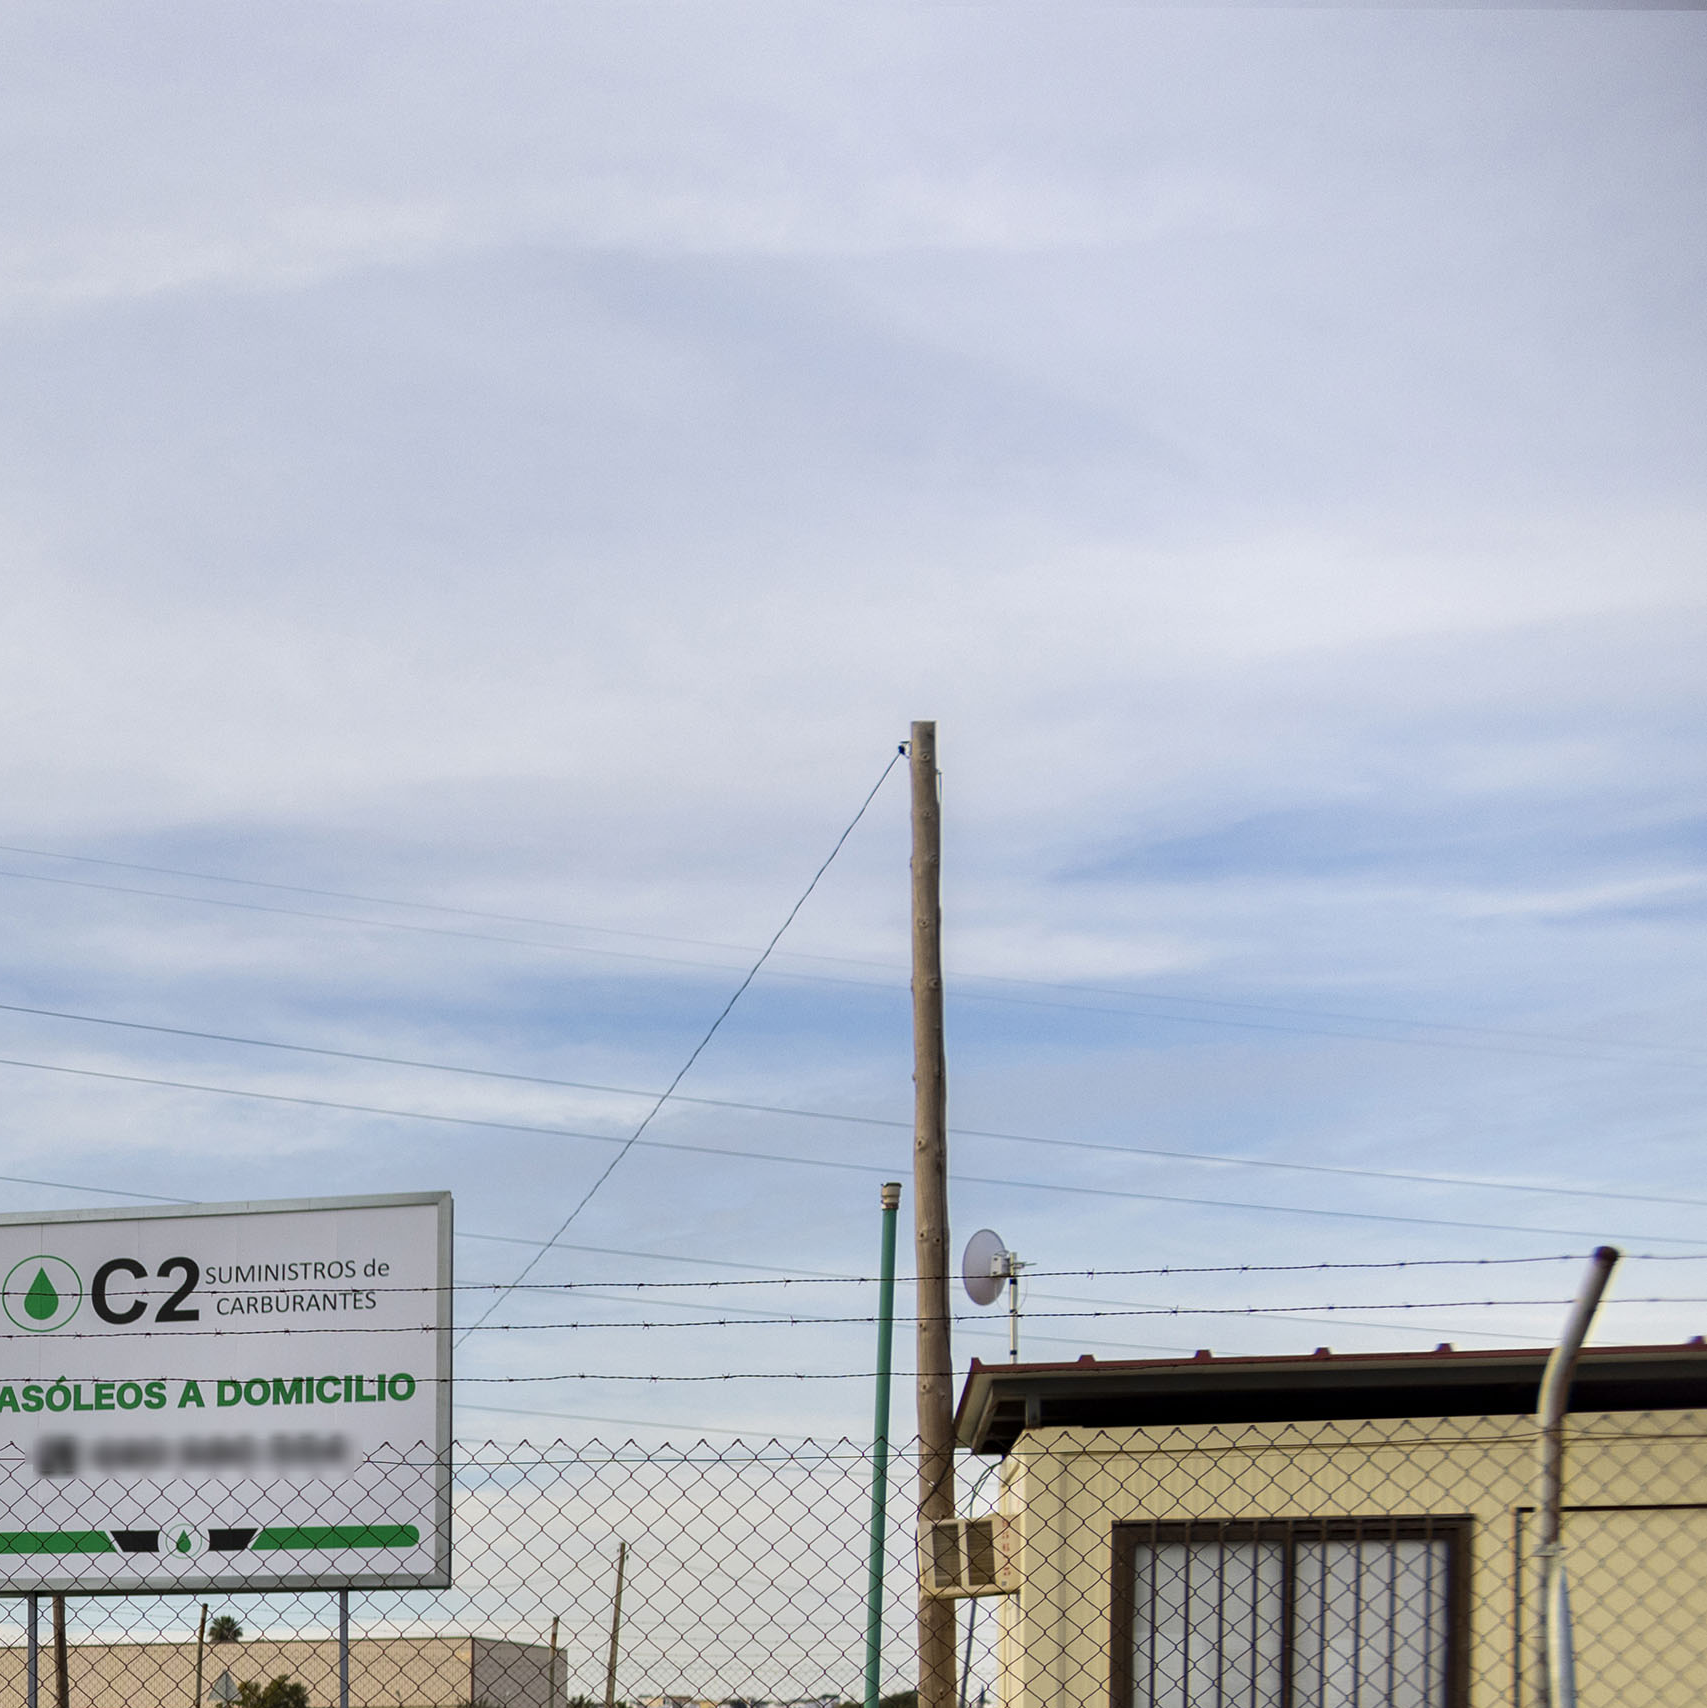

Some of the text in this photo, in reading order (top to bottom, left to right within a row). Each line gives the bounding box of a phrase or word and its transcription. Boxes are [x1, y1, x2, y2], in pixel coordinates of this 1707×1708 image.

[205, 1258, 390, 1285] SUMINISTROS de
[91, 1256, 201, 1326] C2
[216, 1291, 377, 1316] CARBURANTES
[177, 1379, 206, 1409] A
[216, 1372, 417, 1408] DOMICILIO
